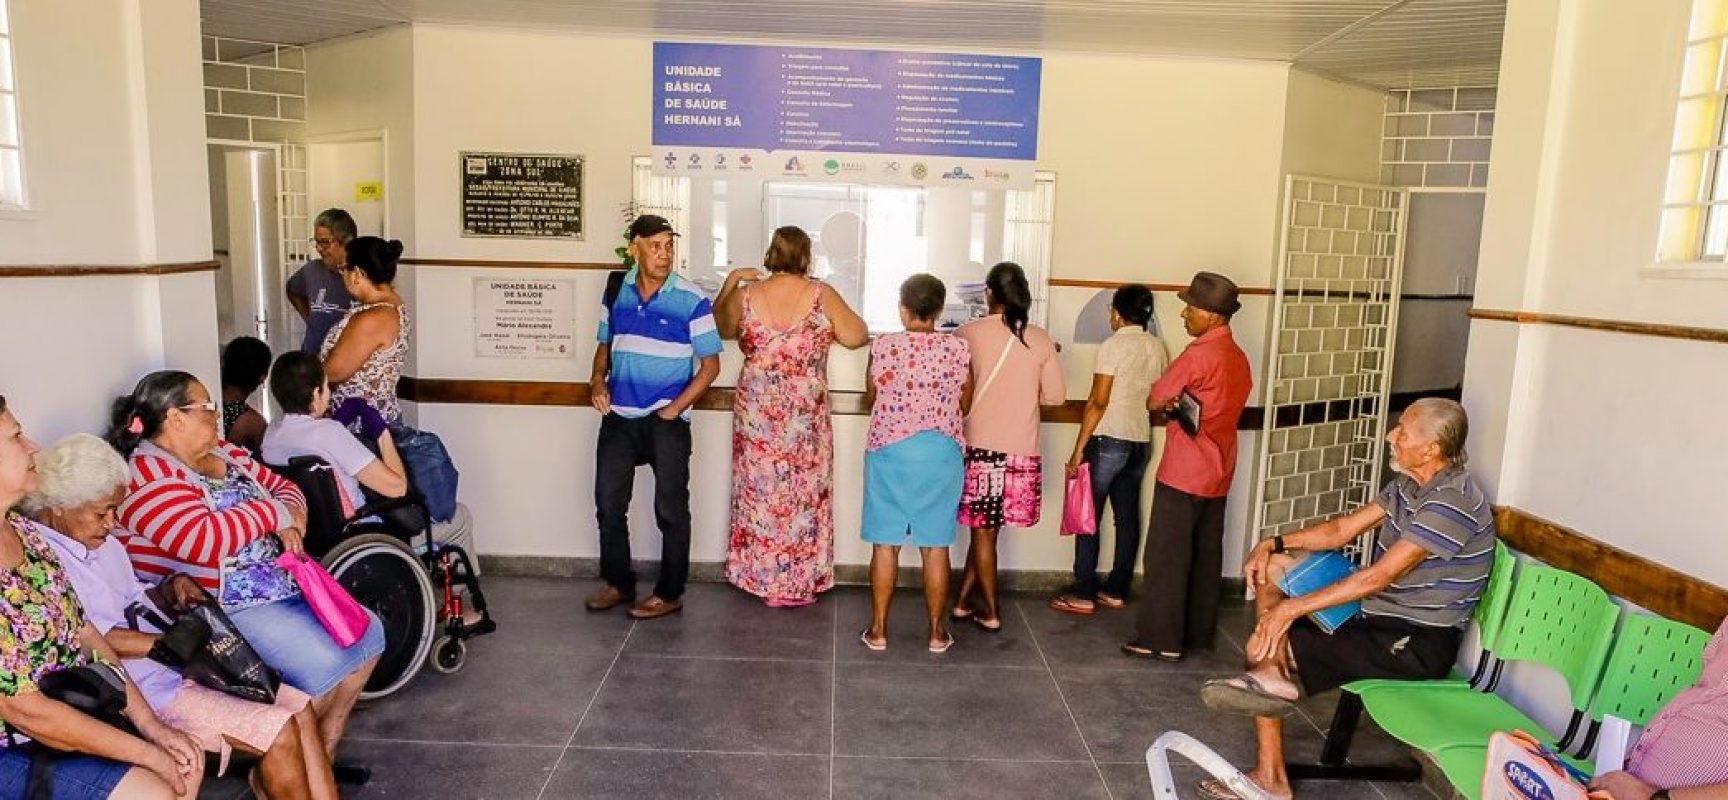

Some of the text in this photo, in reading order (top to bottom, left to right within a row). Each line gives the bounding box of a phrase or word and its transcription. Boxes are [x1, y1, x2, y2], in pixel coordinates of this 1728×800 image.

[665, 66, 722, 77] UNIDADE
[665, 81, 712, 93] BÁSICA
[665, 97, 728, 110] DE SAÚDE
[665, 114, 742, 127] HERNANI SÁ
[527, 282, 557, 290] BÁSICA
[517, 290, 543, 298] SAÚDE
